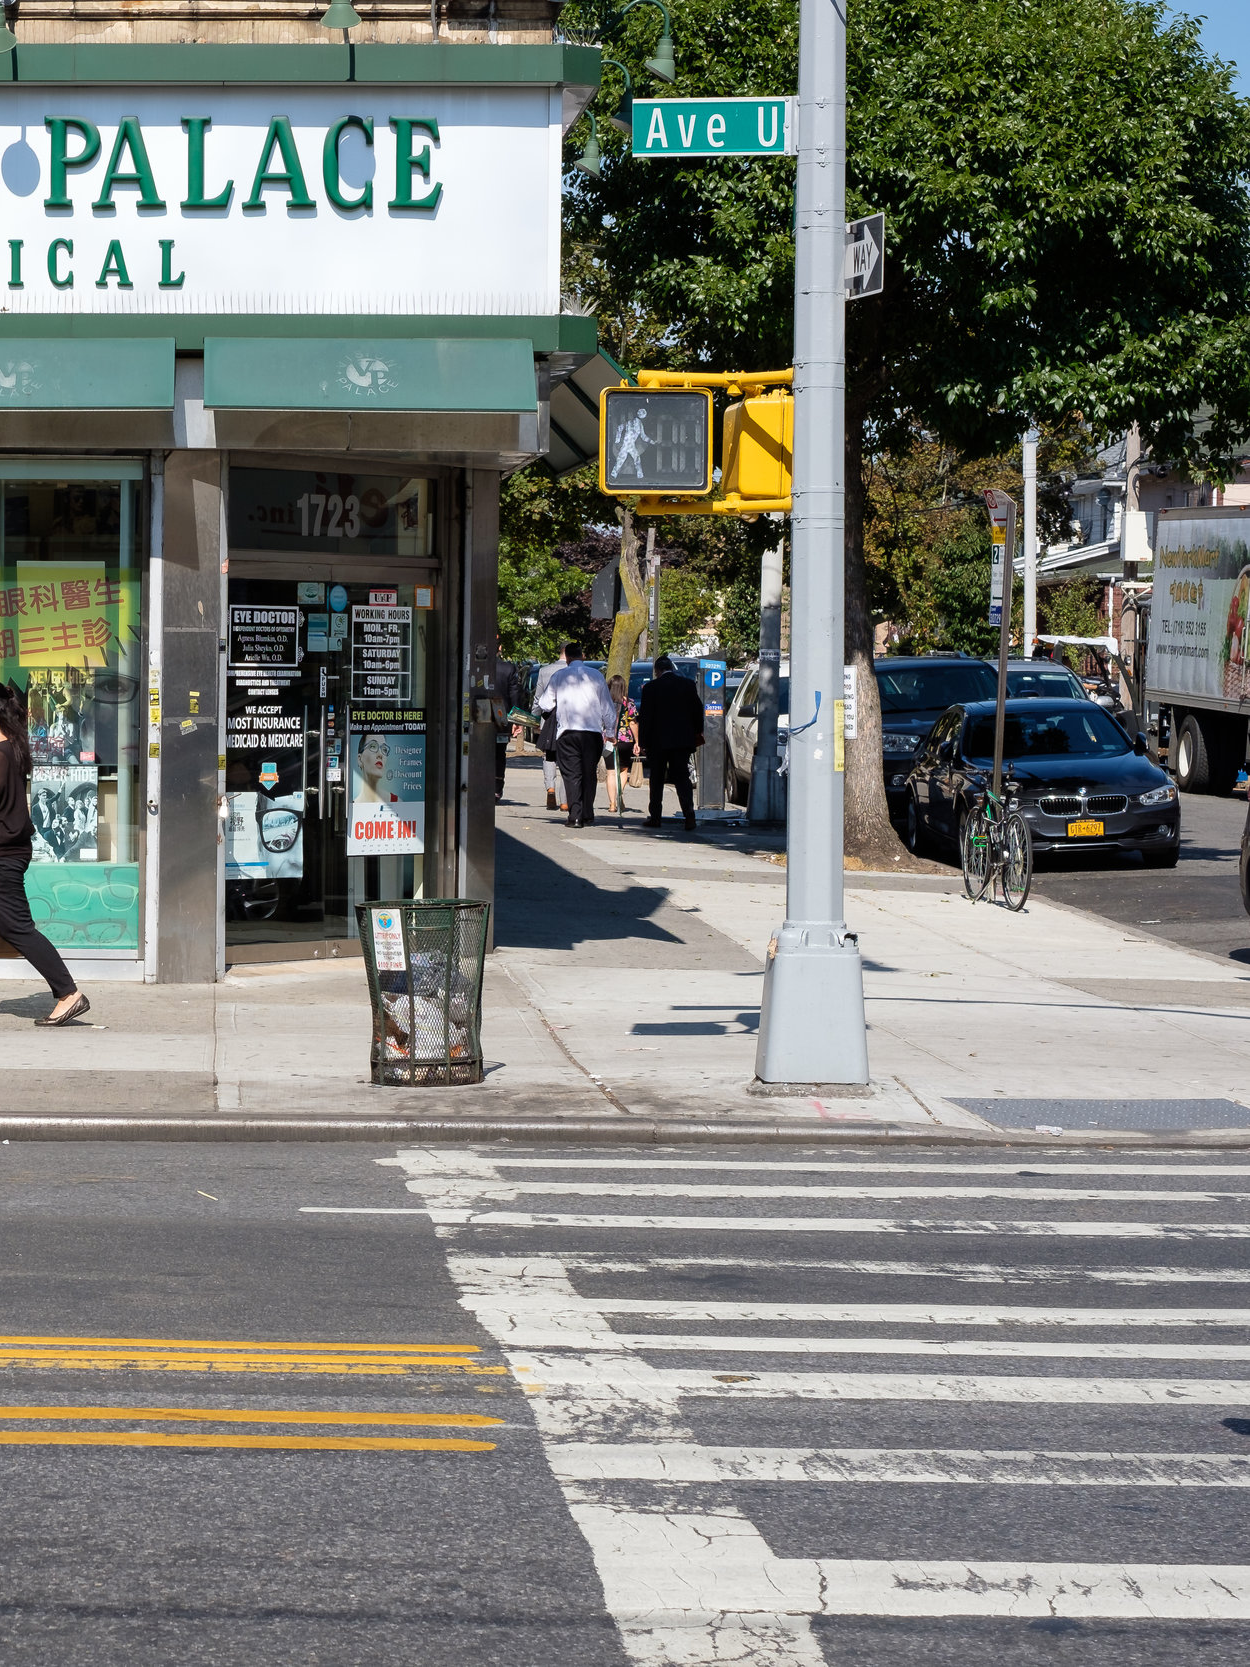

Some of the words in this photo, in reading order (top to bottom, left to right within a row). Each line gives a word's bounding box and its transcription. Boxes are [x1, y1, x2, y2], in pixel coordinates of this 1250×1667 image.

[646, 107, 726, 148] Ave
[758, 106, 778, 147] U
[41, 114, 443, 212] PALACE
[853, 242, 873, 273] WAY
[336, 377, 399, 396] PALACE
[297, 493, 361, 538] 1723
[234, 610, 252, 623] EYE
[253, 611, 295, 624] DOCTOR
[355, 609, 385, 619] WORKING
[388, 610, 410, 620] HOURS
[388, 624, 400, 633] FR.
[364, 634, 400, 645] 10am-7pm
[362, 649, 400, 658] SATURDAY
[363, 660, 400, 671] 10am-6pm
[30, 670, 64, 685] NEVER
[366, 676, 396, 685] SUNDAY
[711, 672, 721, 686] P
[363, 687, 399, 698] 11am-5pm
[245, 706, 256, 714] WE
[257, 706, 282, 714] ACCEPT
[352, 711, 365, 720] EYE
[367, 711, 394, 720] DOCTOR
[395, 711, 402, 720] IS
[403, 711, 423, 720] HERE!
[227, 717, 252, 729] MOST
[253, 717, 301, 729] INSURANCE
[371, 723, 404, 732] Appointment
[226, 734, 259, 748] MEDICAID
[260, 735, 267, 748] &
[268, 734, 303, 748] MEDICARE
[395, 746, 423, 754] Designer
[399, 758, 422, 766] Frames
[32, 769, 68, 782] NEVER
[70, 768, 97, 782] HIDE
[386, 769, 393, 781] @
[394, 770, 422, 778] Discount
[403, 782, 422, 790] Prices
[355, 821, 394, 840] COME
[397, 820, 417, 838] IN!
